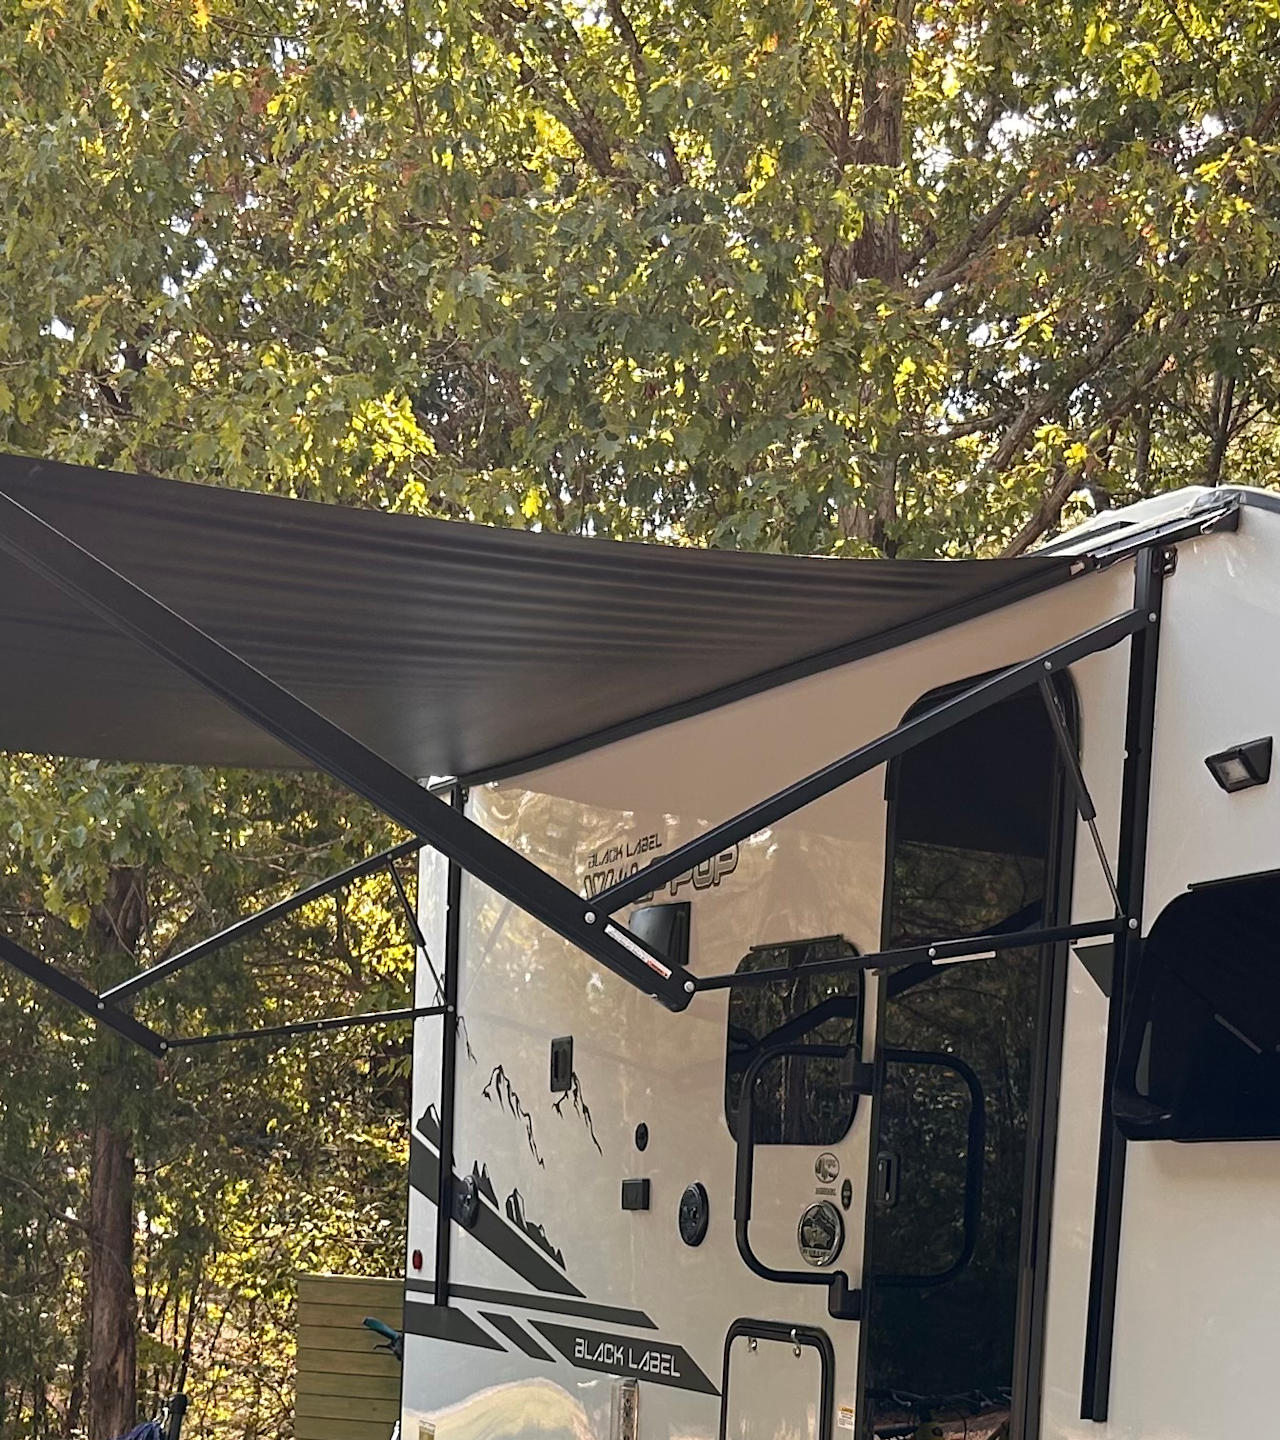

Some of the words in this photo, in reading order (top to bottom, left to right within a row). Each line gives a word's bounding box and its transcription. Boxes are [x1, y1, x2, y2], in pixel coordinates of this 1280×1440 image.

[588, 844, 623, 869] BLACK
[626, 833, 662, 856] LABEL
[574, 1337, 624, 1366] BLACK
[628, 1347, 681, 1378] LABEL
